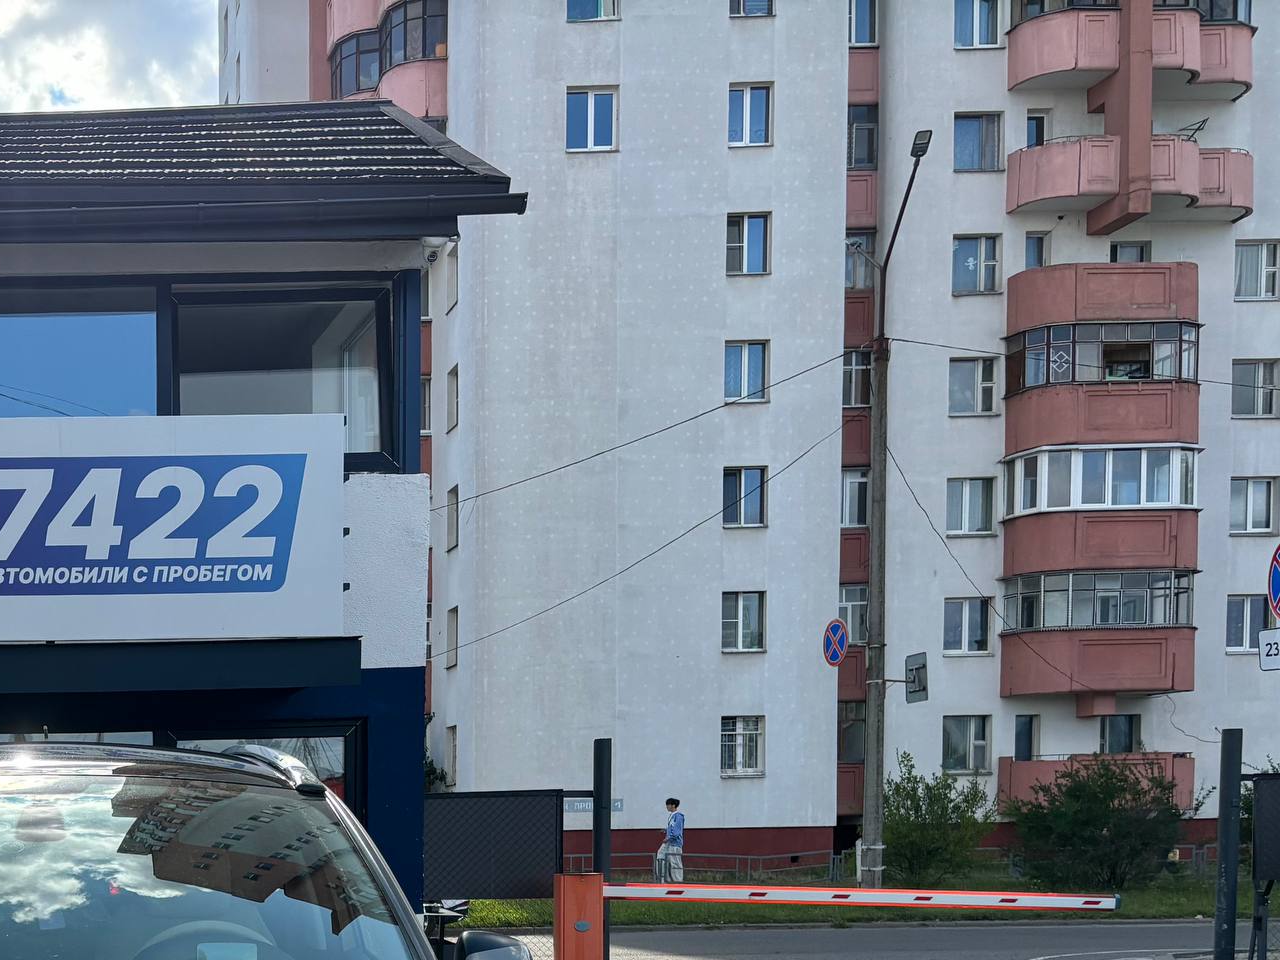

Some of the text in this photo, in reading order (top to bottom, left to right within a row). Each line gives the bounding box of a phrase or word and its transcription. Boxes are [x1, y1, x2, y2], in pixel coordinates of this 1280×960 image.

[132, 566, 148, 583] С
[152, 564, 273, 583] ПРОБЕГОМ
[1265, 642, 1280, 657] 23
